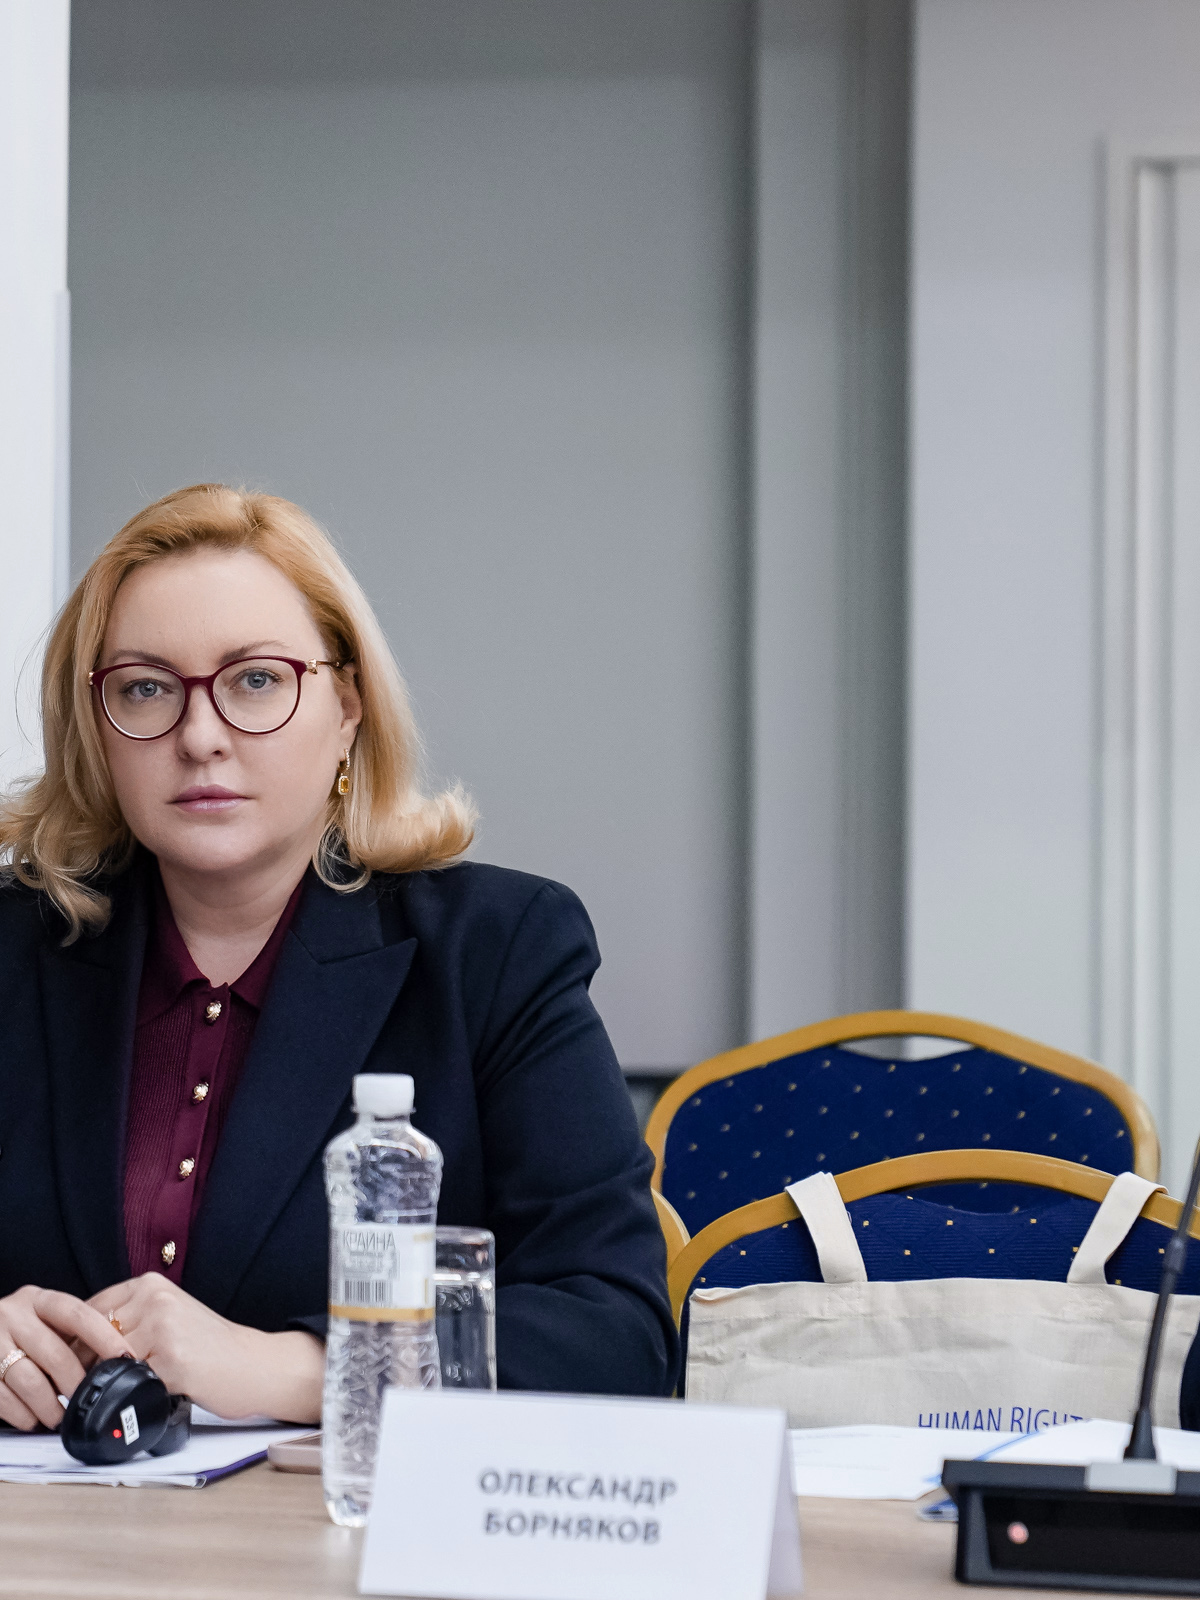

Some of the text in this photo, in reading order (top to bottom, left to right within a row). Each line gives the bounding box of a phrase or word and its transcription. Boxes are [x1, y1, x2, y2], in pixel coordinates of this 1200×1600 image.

[918, 1406, 1001, 1432] HUMAN
[479, 1471, 677, 1510] ОЛЕКСАНДР
[484, 1510, 661, 1545] БОРНЯКОВ
